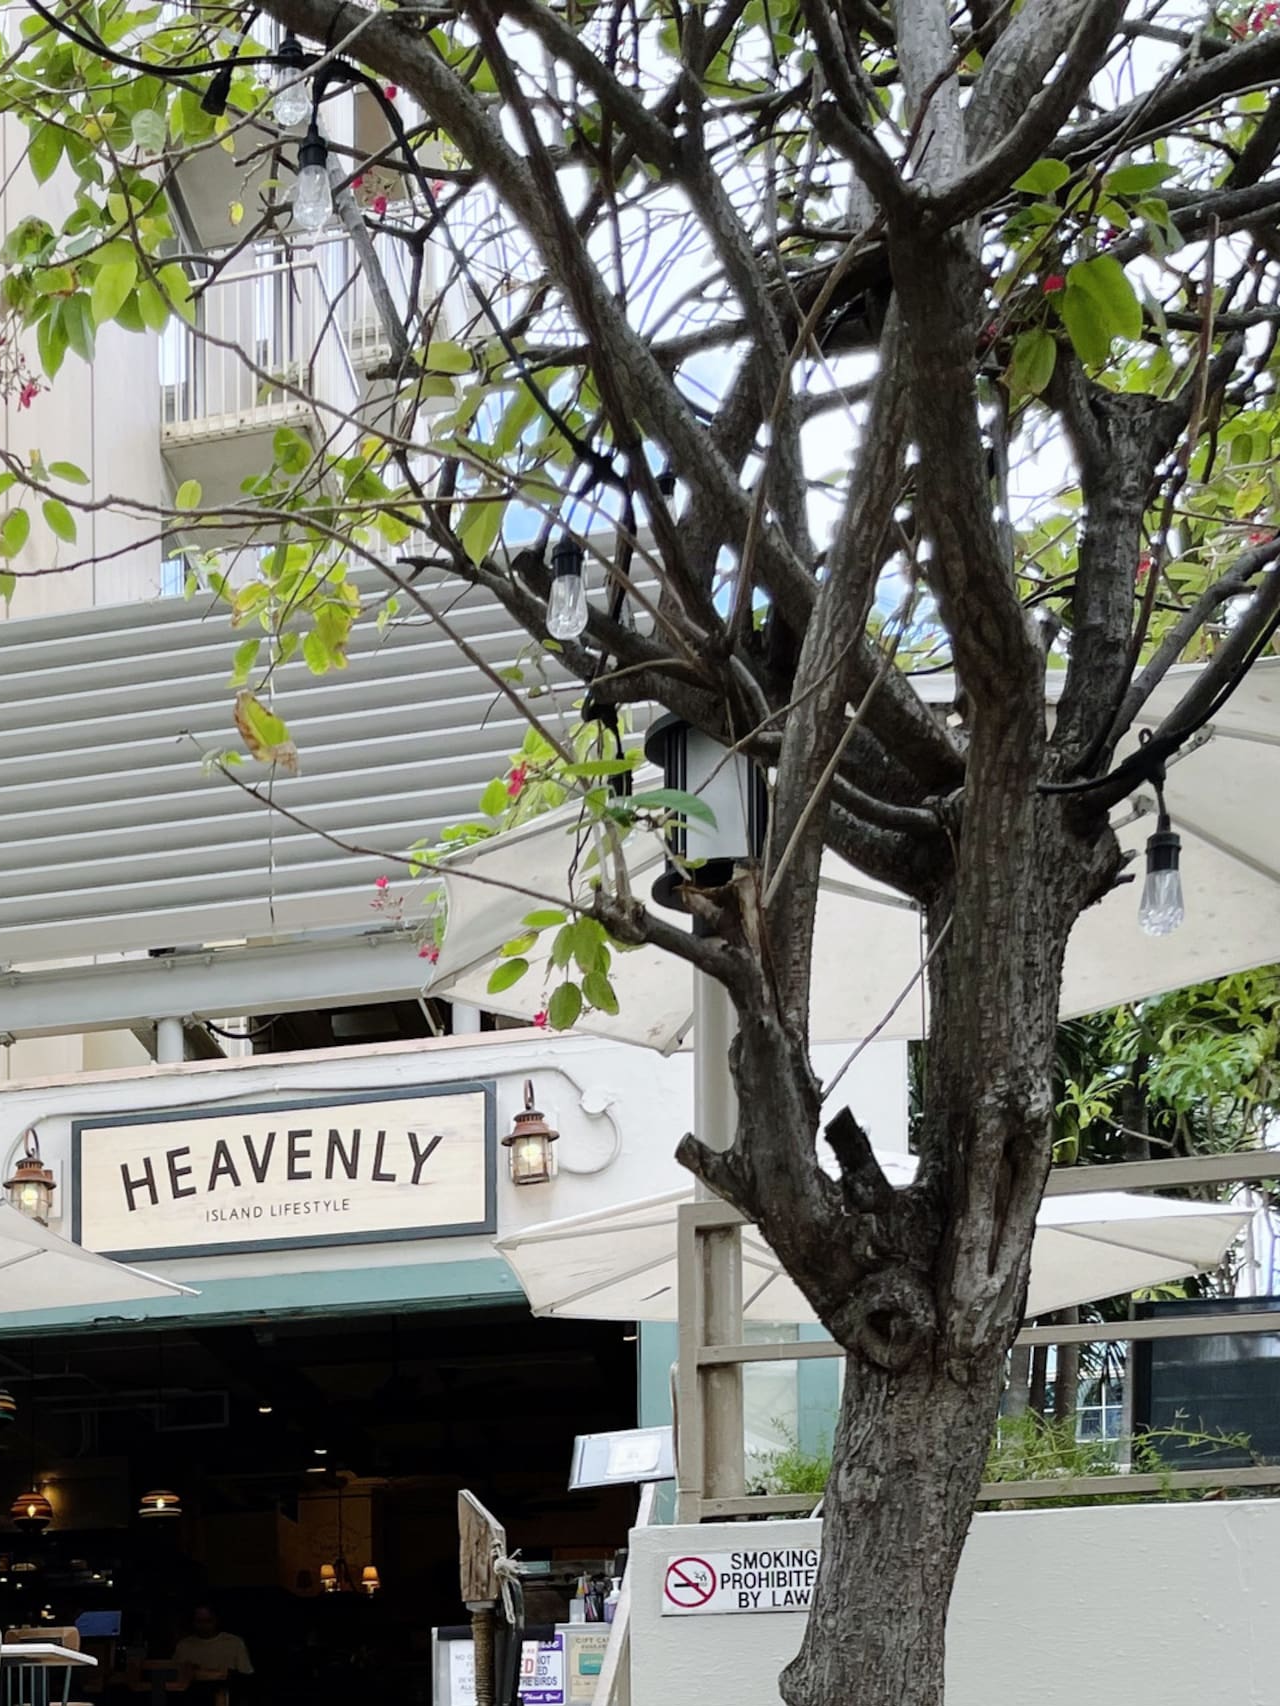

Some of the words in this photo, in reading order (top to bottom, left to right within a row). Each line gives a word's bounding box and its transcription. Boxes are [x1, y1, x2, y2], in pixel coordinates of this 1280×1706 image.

[121, 1128, 443, 1211] HEAVENLY
[206, 1206, 263, 1223] ISLAND
[270, 1199, 351, 1218] LIFESTYLE
[731, 1550, 818, 1570] SMOKING
[720, 1570, 815, 1590] PROHIBITE
[738, 1591, 762, 1608] BY
[772, 1590, 811, 1607] LAW
